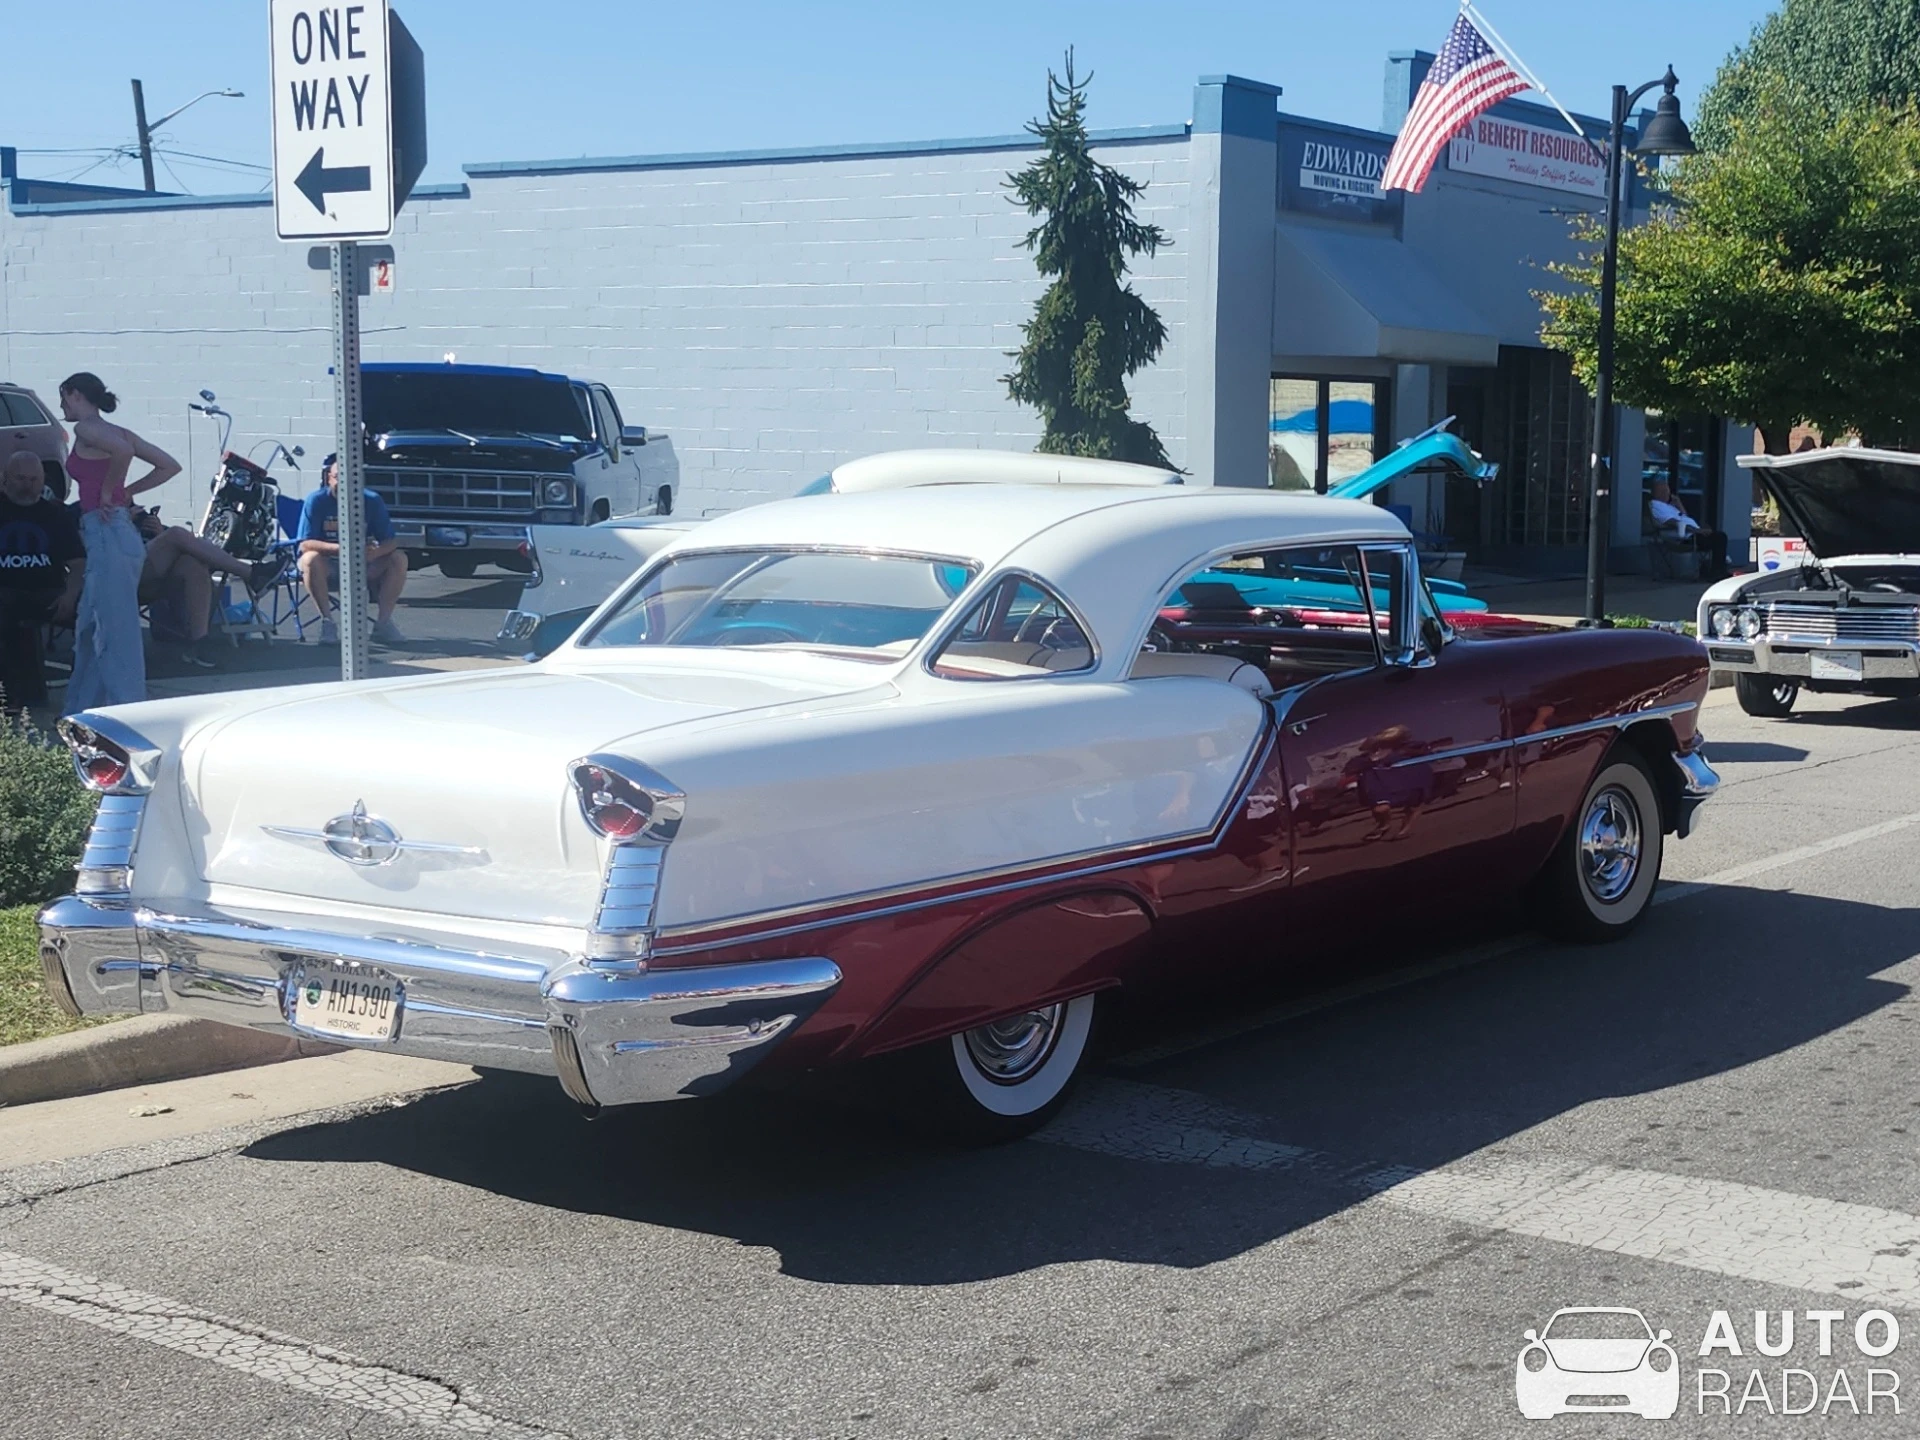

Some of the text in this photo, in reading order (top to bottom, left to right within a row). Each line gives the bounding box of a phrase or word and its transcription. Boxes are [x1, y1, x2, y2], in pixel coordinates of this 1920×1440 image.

[292, 6, 367, 65] ONE
[291, 74, 370, 132] WAY
[1301, 140, 1388, 179] EDWARDS
[1478, 119, 1529, 153] BENEFIT
[1530, 131, 1600, 168] RESOURCES
[378, 260, 389, 287] 2
[0, 553, 52, 568] MOPAR
[327, 978, 391, 1020] AH139Q
[327, 1018, 361, 1031] HISTORIC
[376, 1026, 388, 1036] 49
